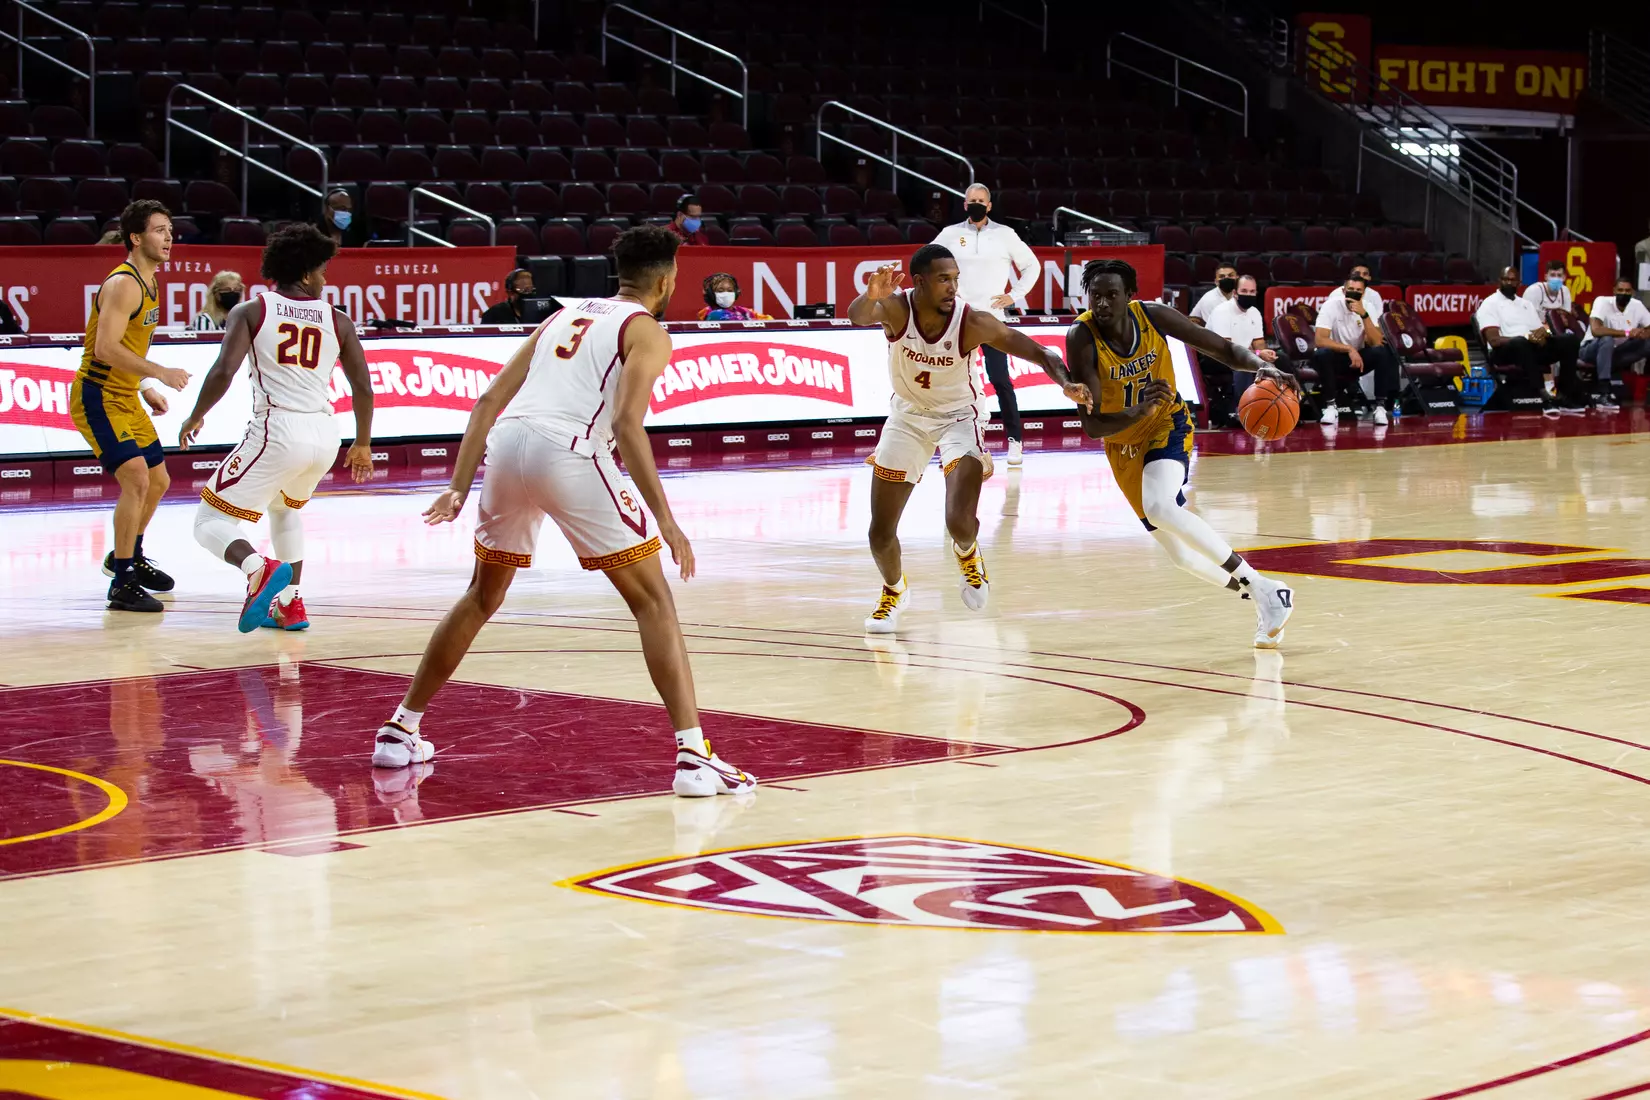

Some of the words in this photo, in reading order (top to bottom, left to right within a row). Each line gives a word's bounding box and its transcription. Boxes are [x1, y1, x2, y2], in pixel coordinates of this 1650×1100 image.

[1379, 59, 1504, 93] FIGHT
[1515, 65, 1583, 98] ON!
[155, 261, 212, 273] ERVEZA
[375, 264, 439, 275] CERVEZA
[276, 303, 323, 324] E.ANDERSON
[1414, 294, 1467, 313] ROCKET
[276, 321, 322, 370] 20
[555, 317, 594, 361] 3
[902, 345, 954, 366] TROJANS
[1109, 347, 1158, 381] LANCERS
[763, 348, 844, 393] JOHN
[914, 371, 931, 389] 4
[0, 368, 71, 415] JOH
